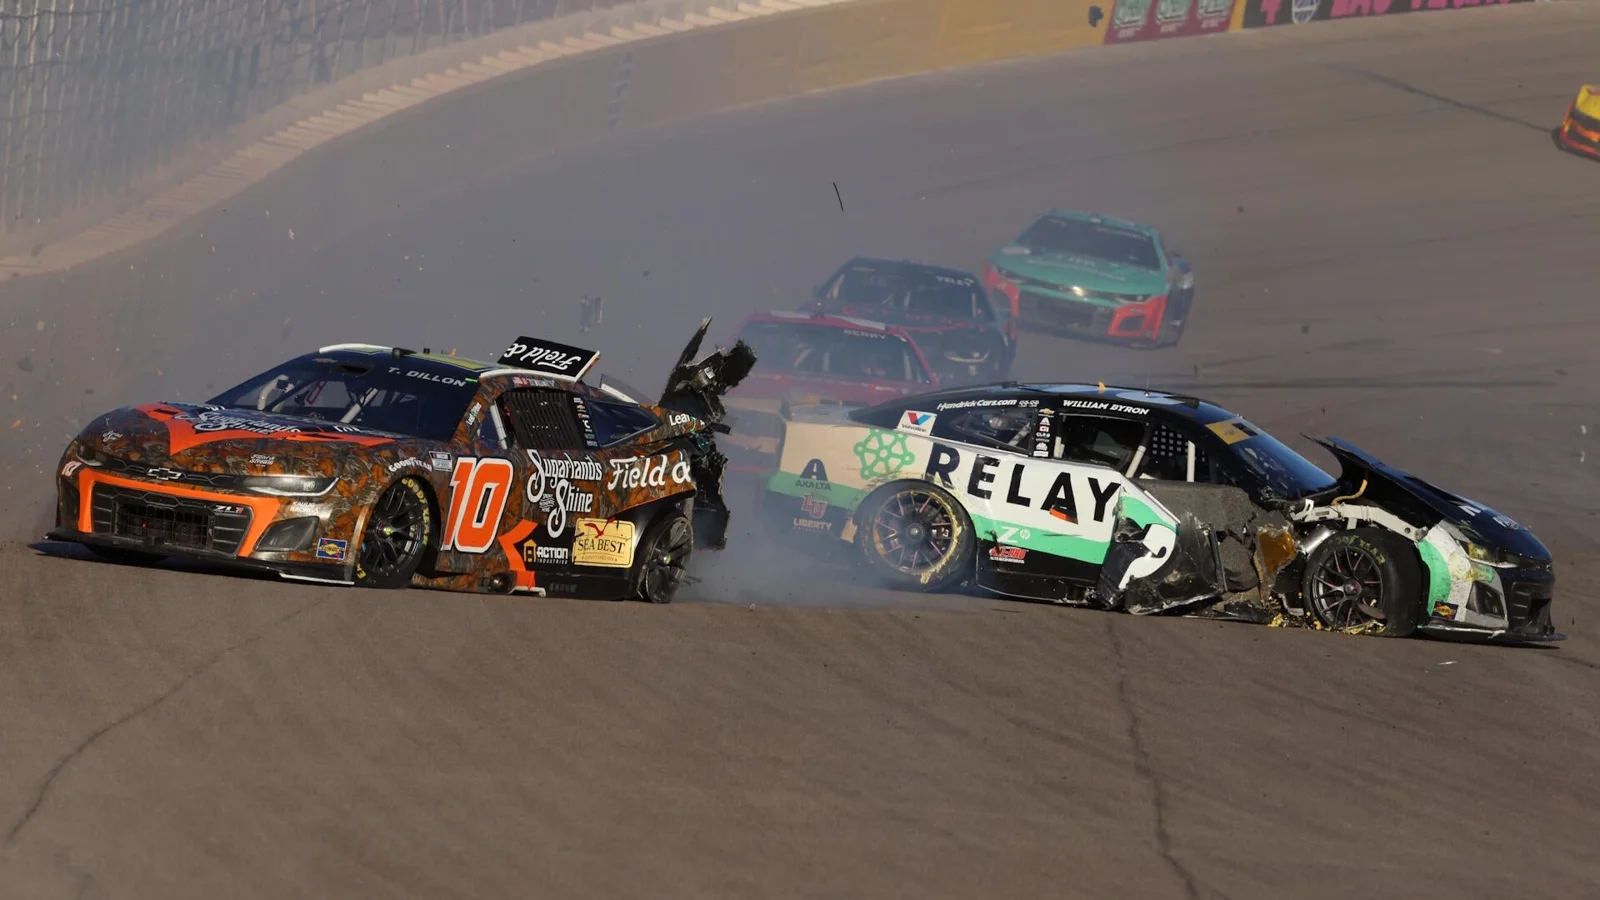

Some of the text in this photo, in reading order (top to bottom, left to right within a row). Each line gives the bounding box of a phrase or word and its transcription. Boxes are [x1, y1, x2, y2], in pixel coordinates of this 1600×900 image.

[520, 346, 581, 371] Field
[388, 366, 467, 387] T. DILLON
[1062, 399, 1150, 415] WILLIAM BYRON
[388, 457, 433, 472] GOODYEAR
[607, 454, 667, 491] Field
[527, 449, 603, 503] Sugarlands
[925, 442, 1121, 525] RELAY
[795, 480, 831, 492] AXALTA
[213, 504, 245, 514] ZL1
[440, 456, 514, 553] 10
[547, 479, 593, 539] Shine
[793, 518, 832, 530] LIBERTY
[537, 546, 569, 560] ACTION
[577, 538, 626, 555] SEA BEST
